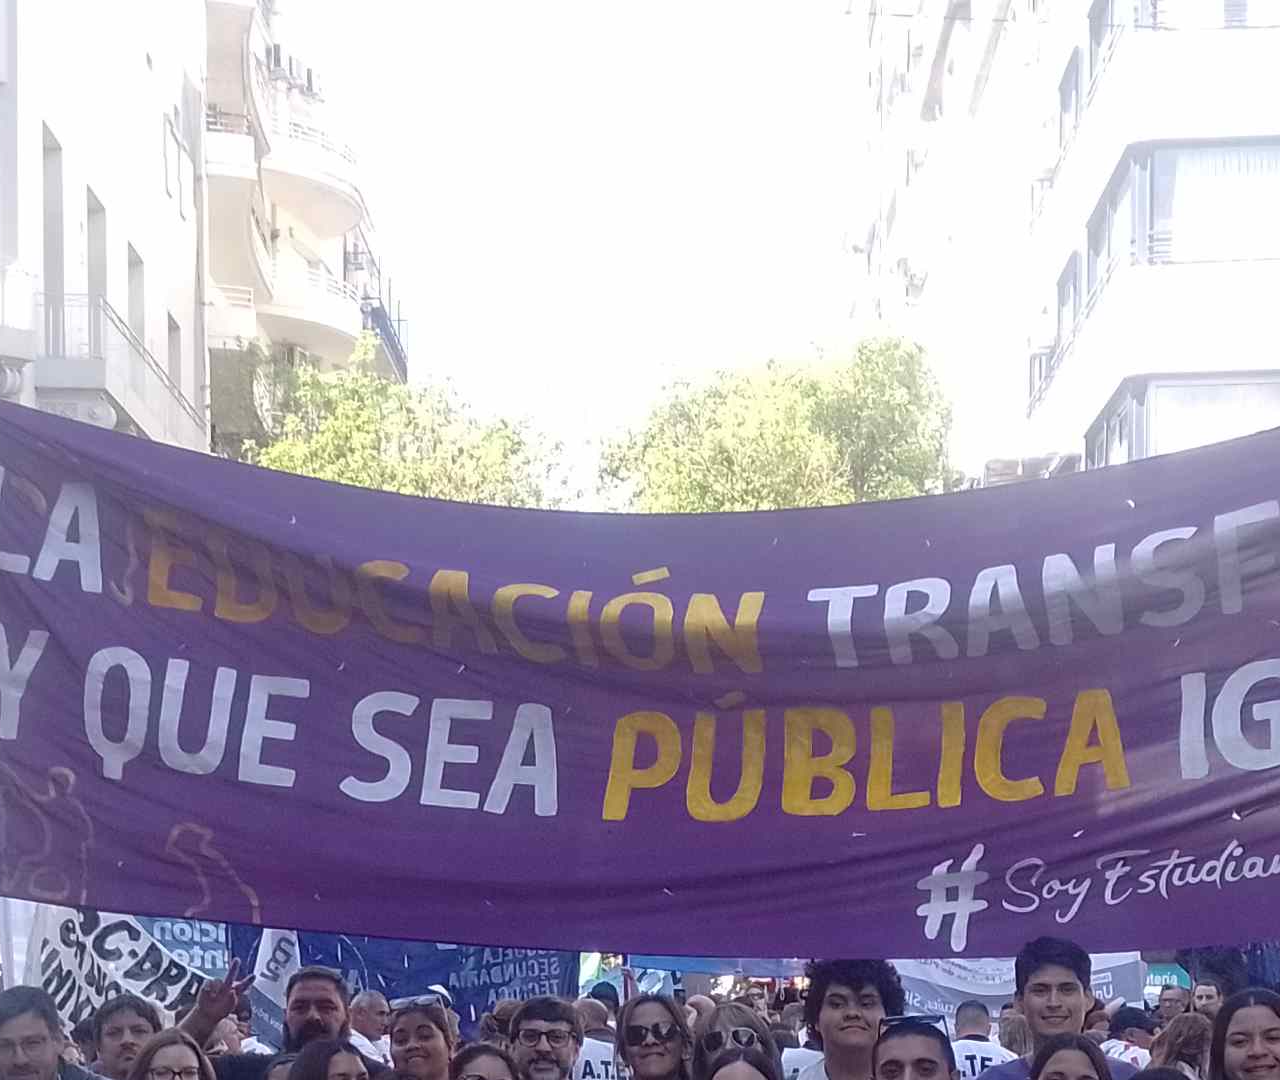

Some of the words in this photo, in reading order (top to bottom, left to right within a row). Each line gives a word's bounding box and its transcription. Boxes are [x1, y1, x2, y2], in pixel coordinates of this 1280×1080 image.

[144, 507, 765, 674] EDUCACIÓN
[83, 646, 311, 788] QUE
[339, 690, 558, 817] SEA
[601, 688, 1132, 823] PÚBLICA
